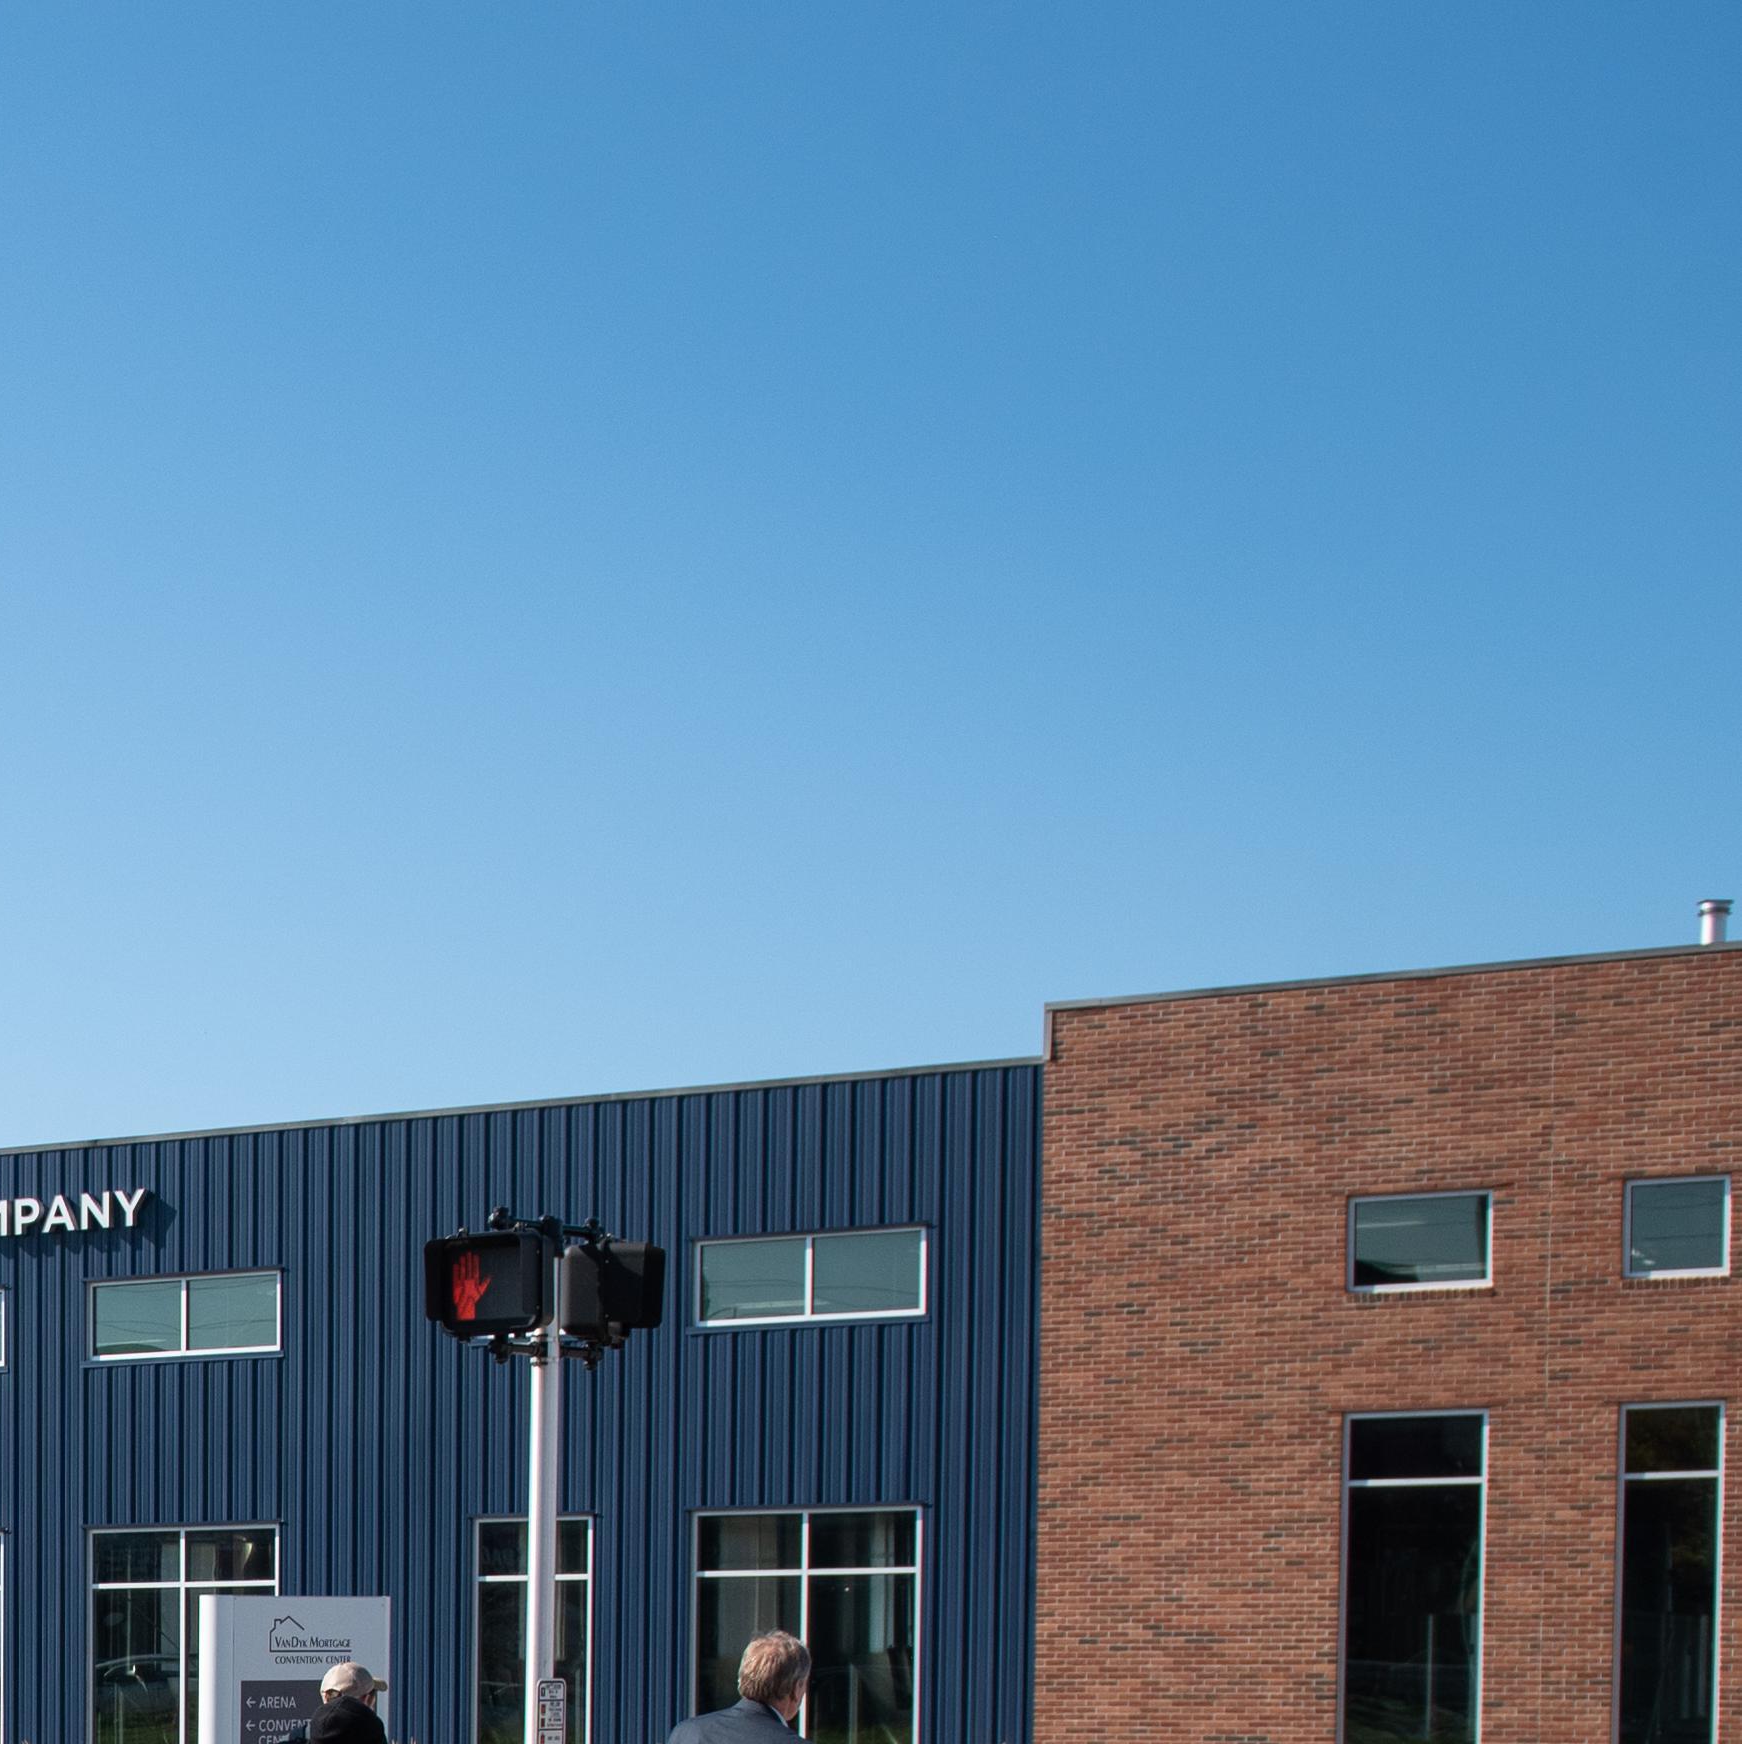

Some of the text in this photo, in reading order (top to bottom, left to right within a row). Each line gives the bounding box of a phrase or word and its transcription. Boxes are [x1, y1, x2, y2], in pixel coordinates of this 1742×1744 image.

[274, 1655, 351, 1665] CONVENTION CENTER
[259, 1696, 297, 1709] ARENA
